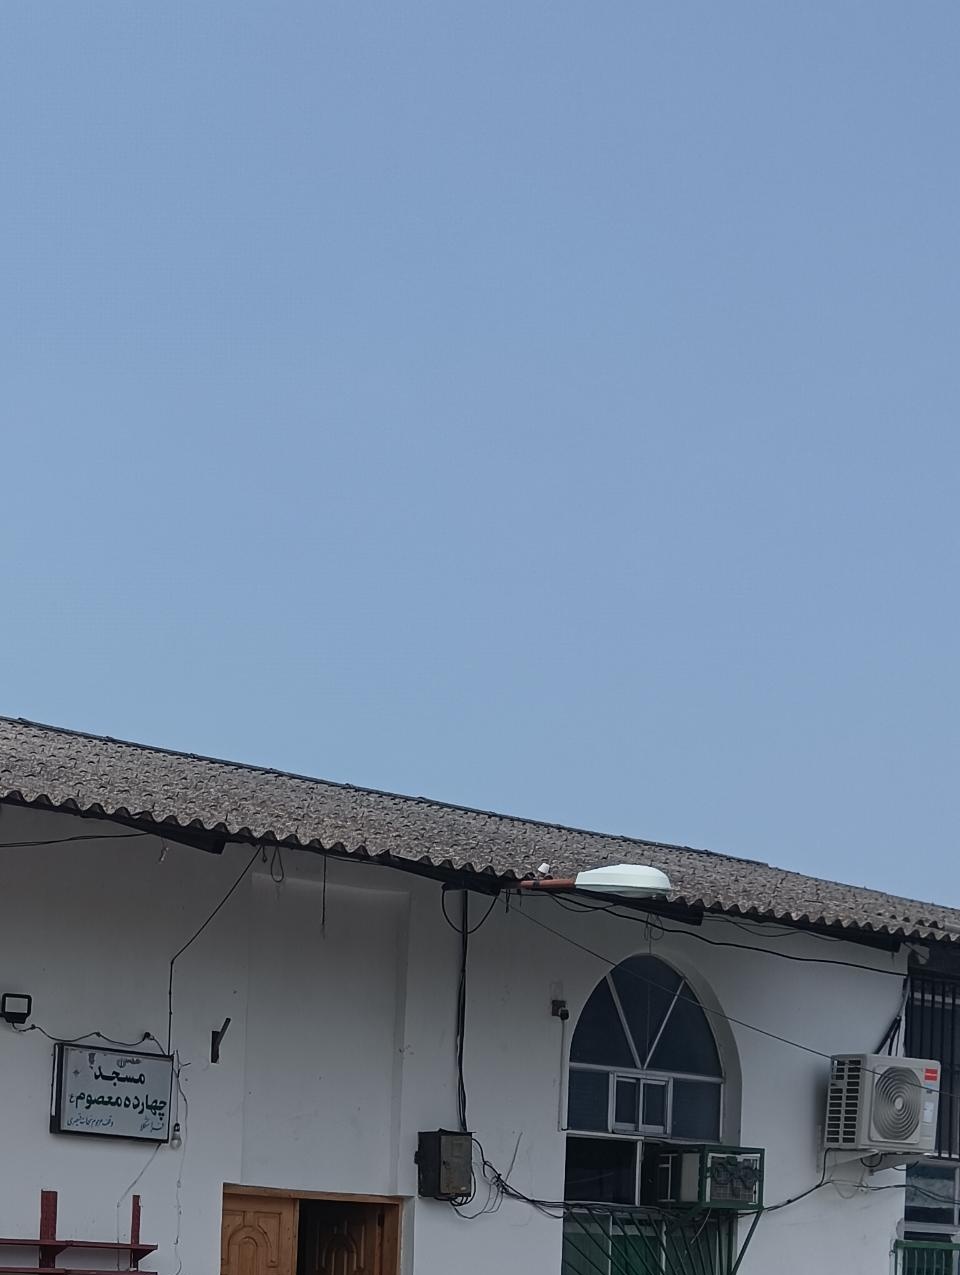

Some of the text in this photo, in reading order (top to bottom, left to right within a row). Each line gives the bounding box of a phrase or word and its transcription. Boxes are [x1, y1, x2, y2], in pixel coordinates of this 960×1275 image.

[94, 1066, 145, 1086] مسجد
[75, 1092, 122, 1109] معصوم
[123, 1094, 167, 1121] چهارده
